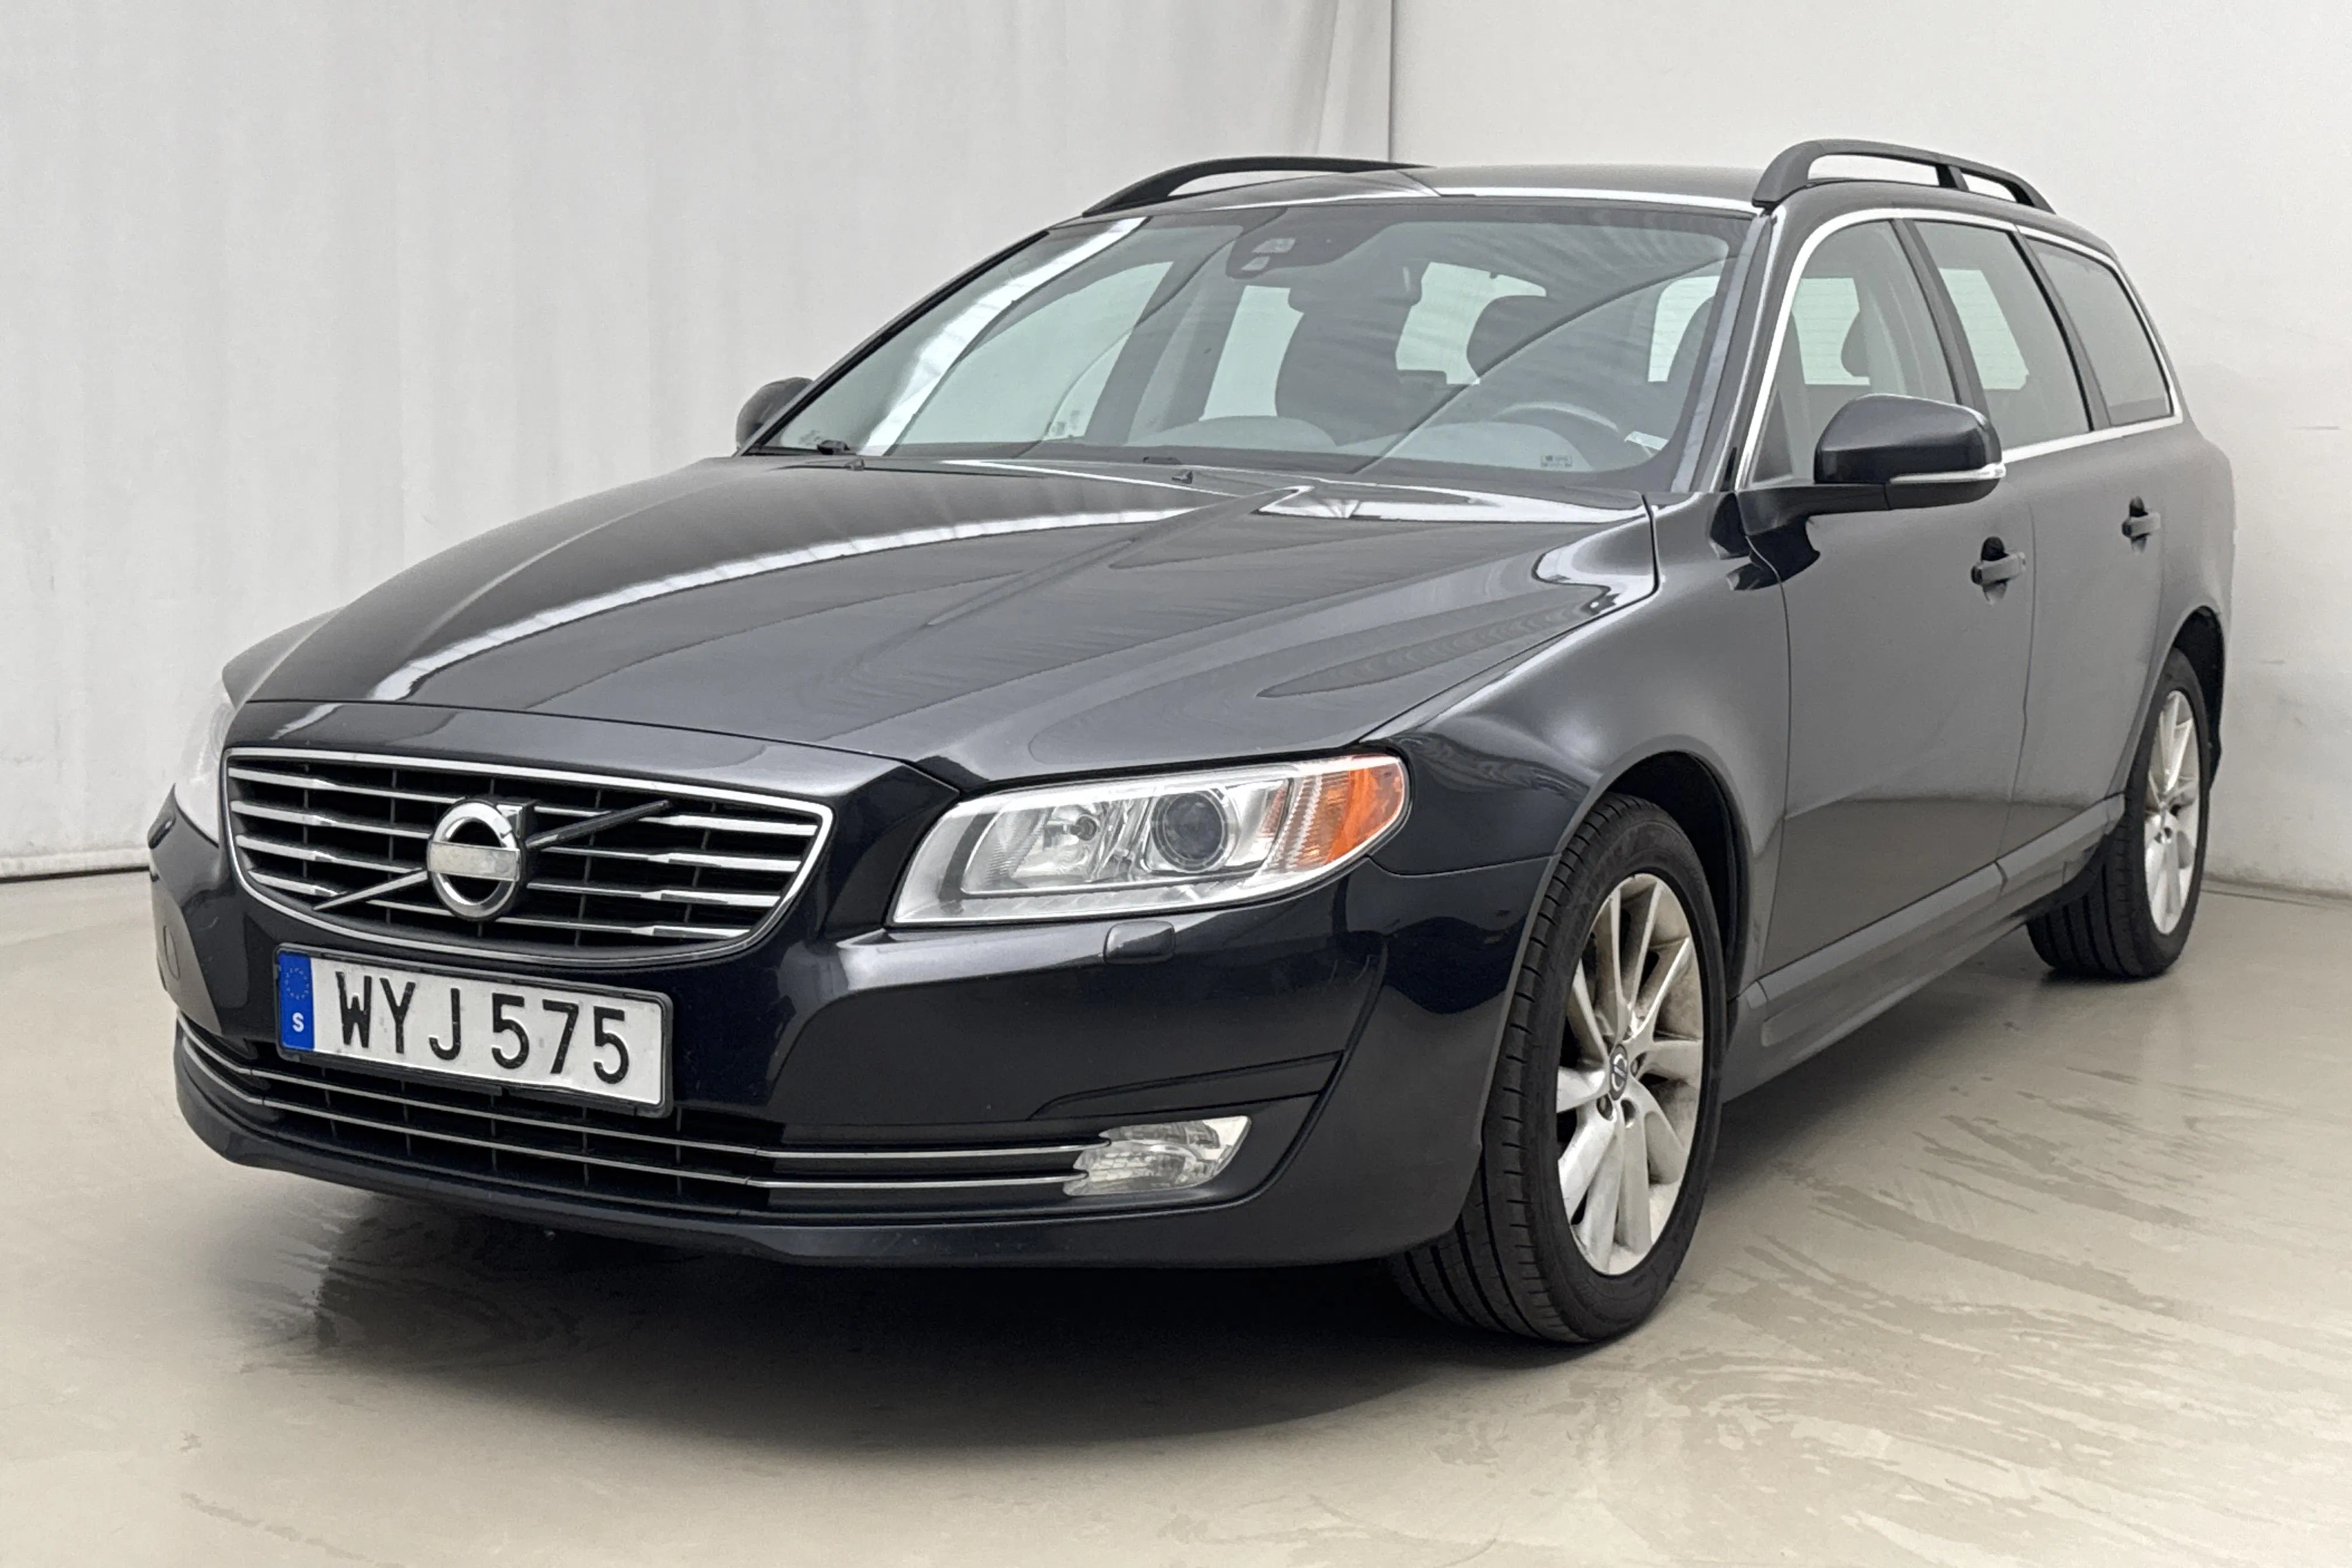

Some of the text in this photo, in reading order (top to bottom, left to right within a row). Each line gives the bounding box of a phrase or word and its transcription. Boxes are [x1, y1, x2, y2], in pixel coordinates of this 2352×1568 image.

[292, 1012, 304, 1032] S
[335, 971, 629, 1084] WYJ 575
